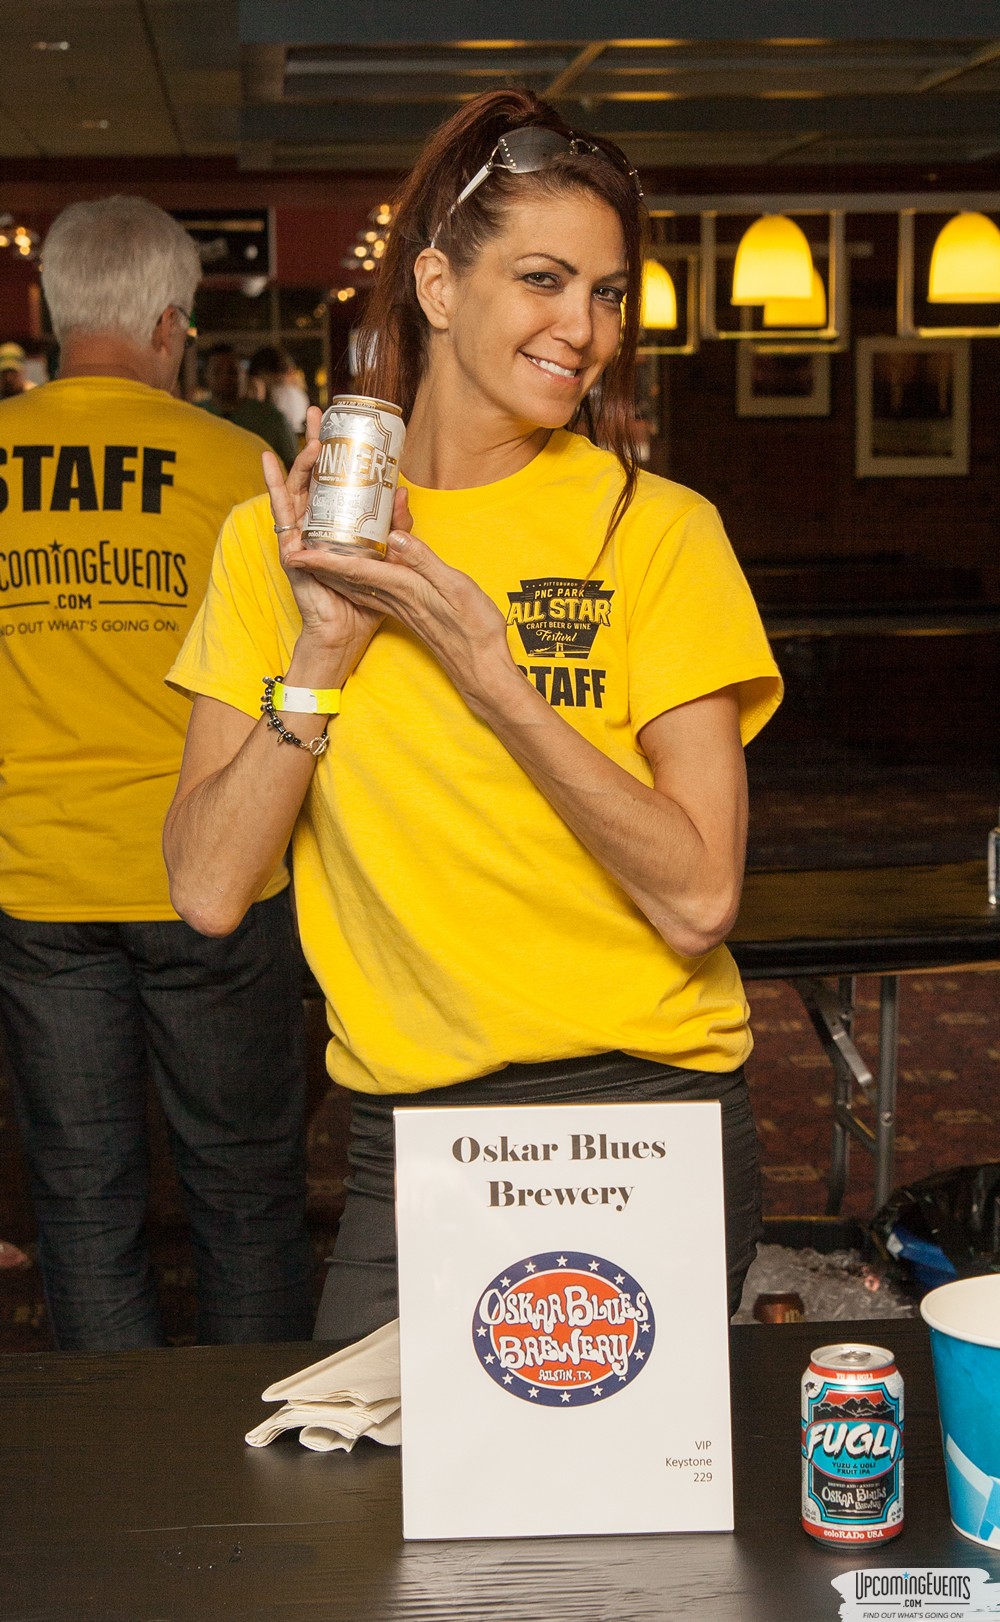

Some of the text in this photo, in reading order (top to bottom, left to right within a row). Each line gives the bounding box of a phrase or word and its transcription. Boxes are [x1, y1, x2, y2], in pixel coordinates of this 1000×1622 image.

[315, 443, 387, 482] INNER
[0, 444, 177, 514] TAFF
[54, 594, 92, 609] .COM
[534, 588, 585, 600] PNC PARK
[507, 598, 611, 627] ALL STAR
[18, 620, 43, 635] OUT
[48, 619, 98, 632] WHAT'S
[101, 619, 149, 632] GOING
[526, 621, 592, 630] CRAFT BEER & WINE
[535, 629, 578, 642] Festival
[518, 665, 606, 709] TAFF
[452, 1133, 666, 1164] Oskar Blues
[486, 1180, 635, 1212] Brewery
[479, 1285, 649, 1334] OSKAR BLUES
[498, 1329, 630, 1376] BREWERY
[576, 1370, 592, 1381] TX
[694, 1440, 712, 1451] VIP
[807, 1423, 898, 1460] FUGLI
[665, 1457, 712, 1469] Keystone
[832, 1461, 851, 1469] YUZU
[693, 1472, 713, 1482] 229
[821, 1486, 887, 1508] OSKAR BLUES
[866, 1530, 884, 1539] USA
